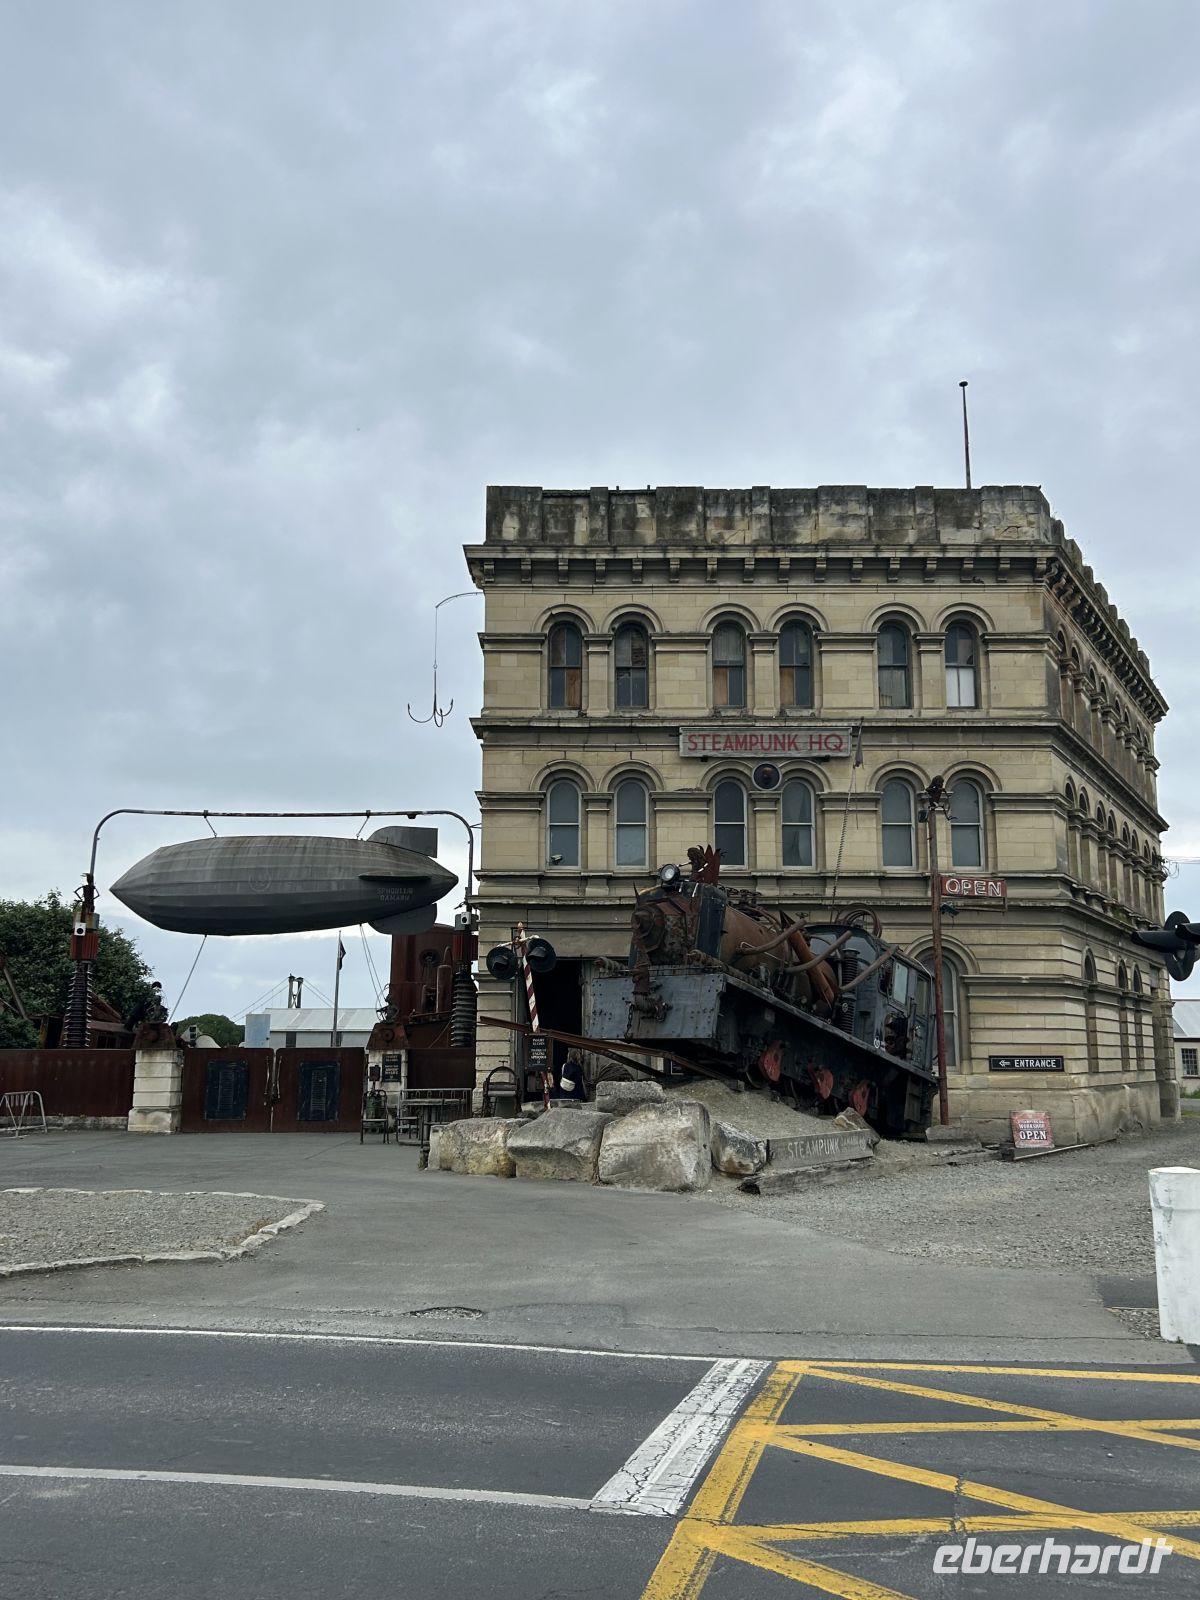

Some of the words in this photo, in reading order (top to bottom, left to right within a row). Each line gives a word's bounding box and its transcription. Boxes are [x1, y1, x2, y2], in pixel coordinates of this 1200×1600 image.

[687, 733, 799, 752] STEAMPUNK
[809, 733, 844, 752] HQ
[945, 878, 1002, 897] OPEN
[1014, 1059, 1057, 1068] ENTRANCE
[1019, 1130, 1047, 1140] OPEN
[787, 1137, 841, 1159] STEAMPUNK
